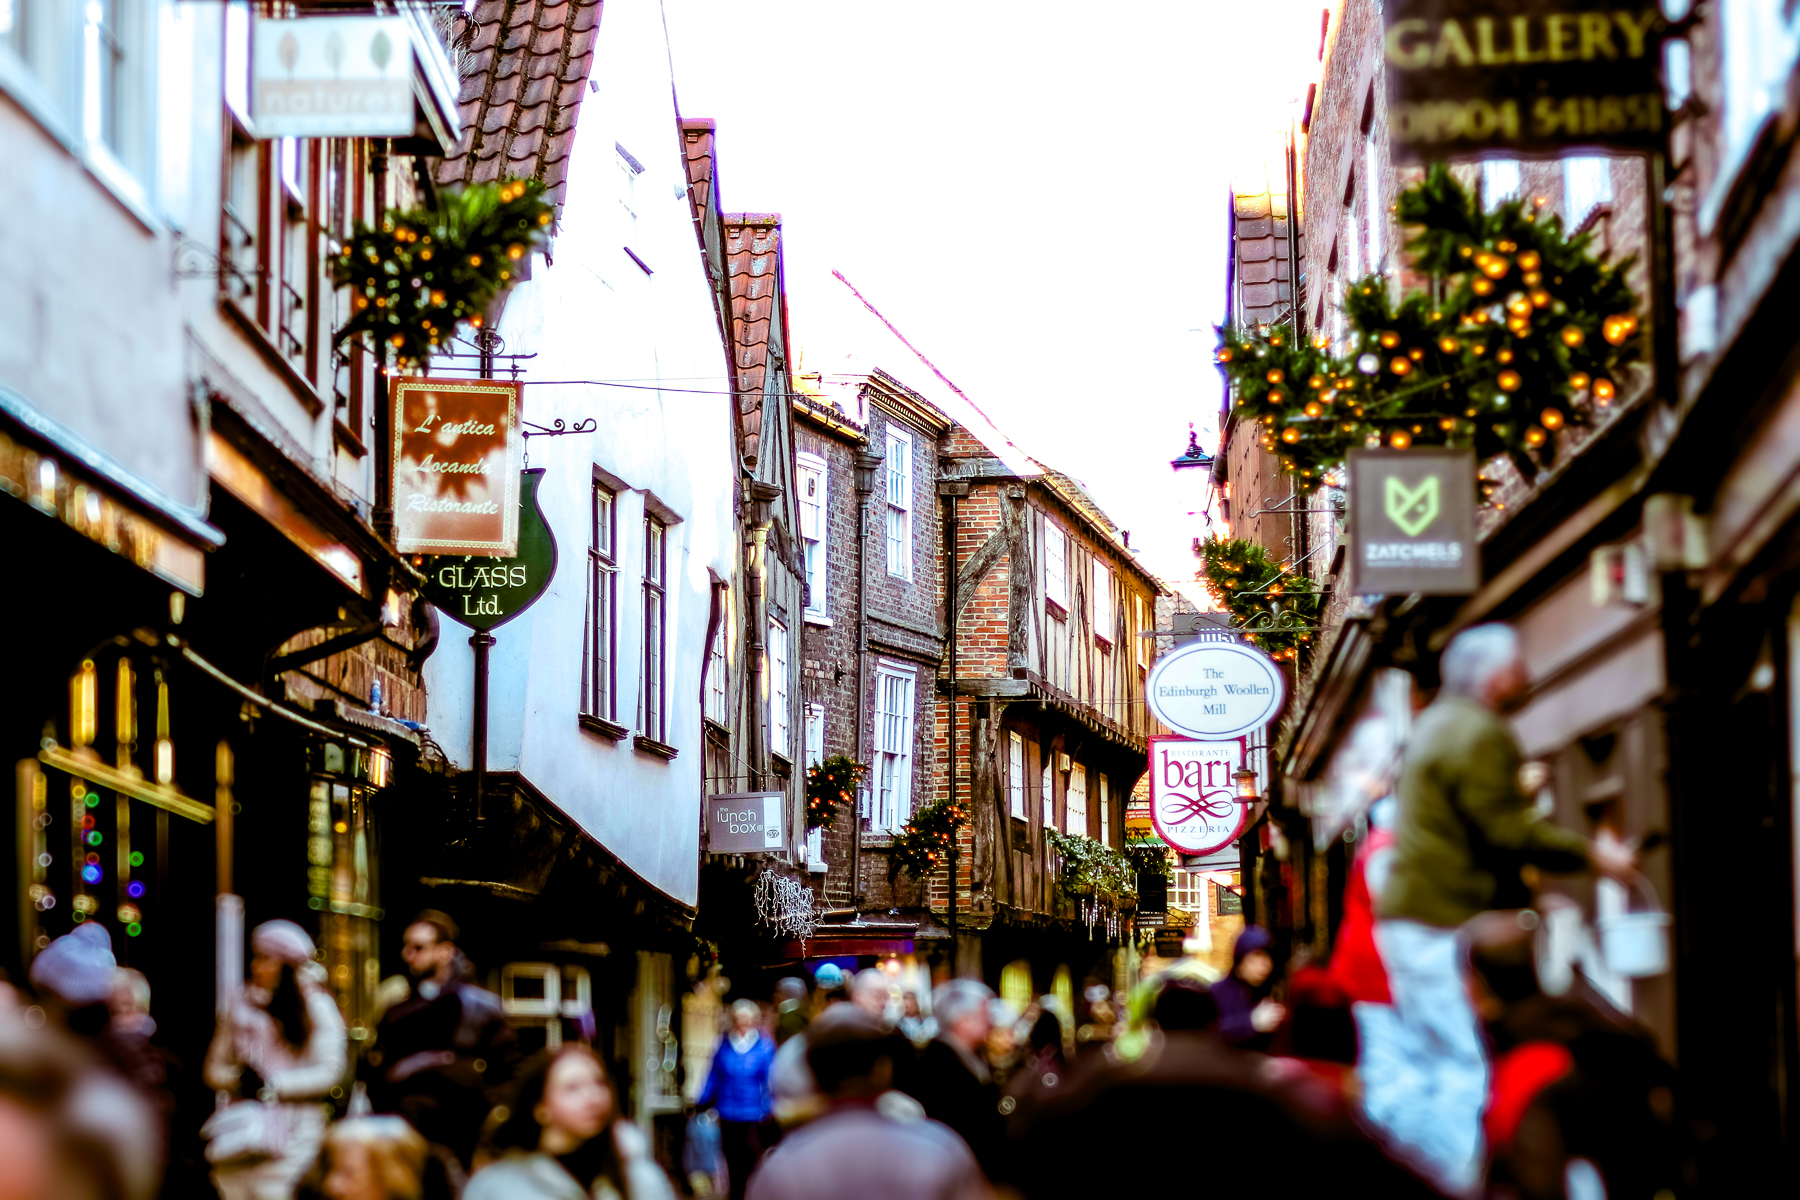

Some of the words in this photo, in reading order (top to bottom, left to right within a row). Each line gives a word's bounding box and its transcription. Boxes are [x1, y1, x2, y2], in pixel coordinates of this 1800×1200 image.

[1385, 10, 1658, 69] GALLERY
[264, 85, 403, 114] natures
[1388, 98, 1520, 143] 01904
[413, 453, 493, 475] Locanda
[405, 493, 499, 515] Ristorante
[1365, 541, 1463, 561] ZATCHELS
[439, 565, 527, 592] GLASS
[462, 594, 504, 616] Ltd.
[1202, 668, 1224, 679] The
[1158, 685, 1218, 699] Edinburgh
[1223, 684, 1270, 695] Woollen
[1203, 703, 1227, 715] Mill
[1171, 749, 1231, 757] RISTORANTE
[1160, 748, 1235, 789] bari
[717, 809, 757, 823] lunch
[1167, 825, 1230, 834] PIZZERIA
